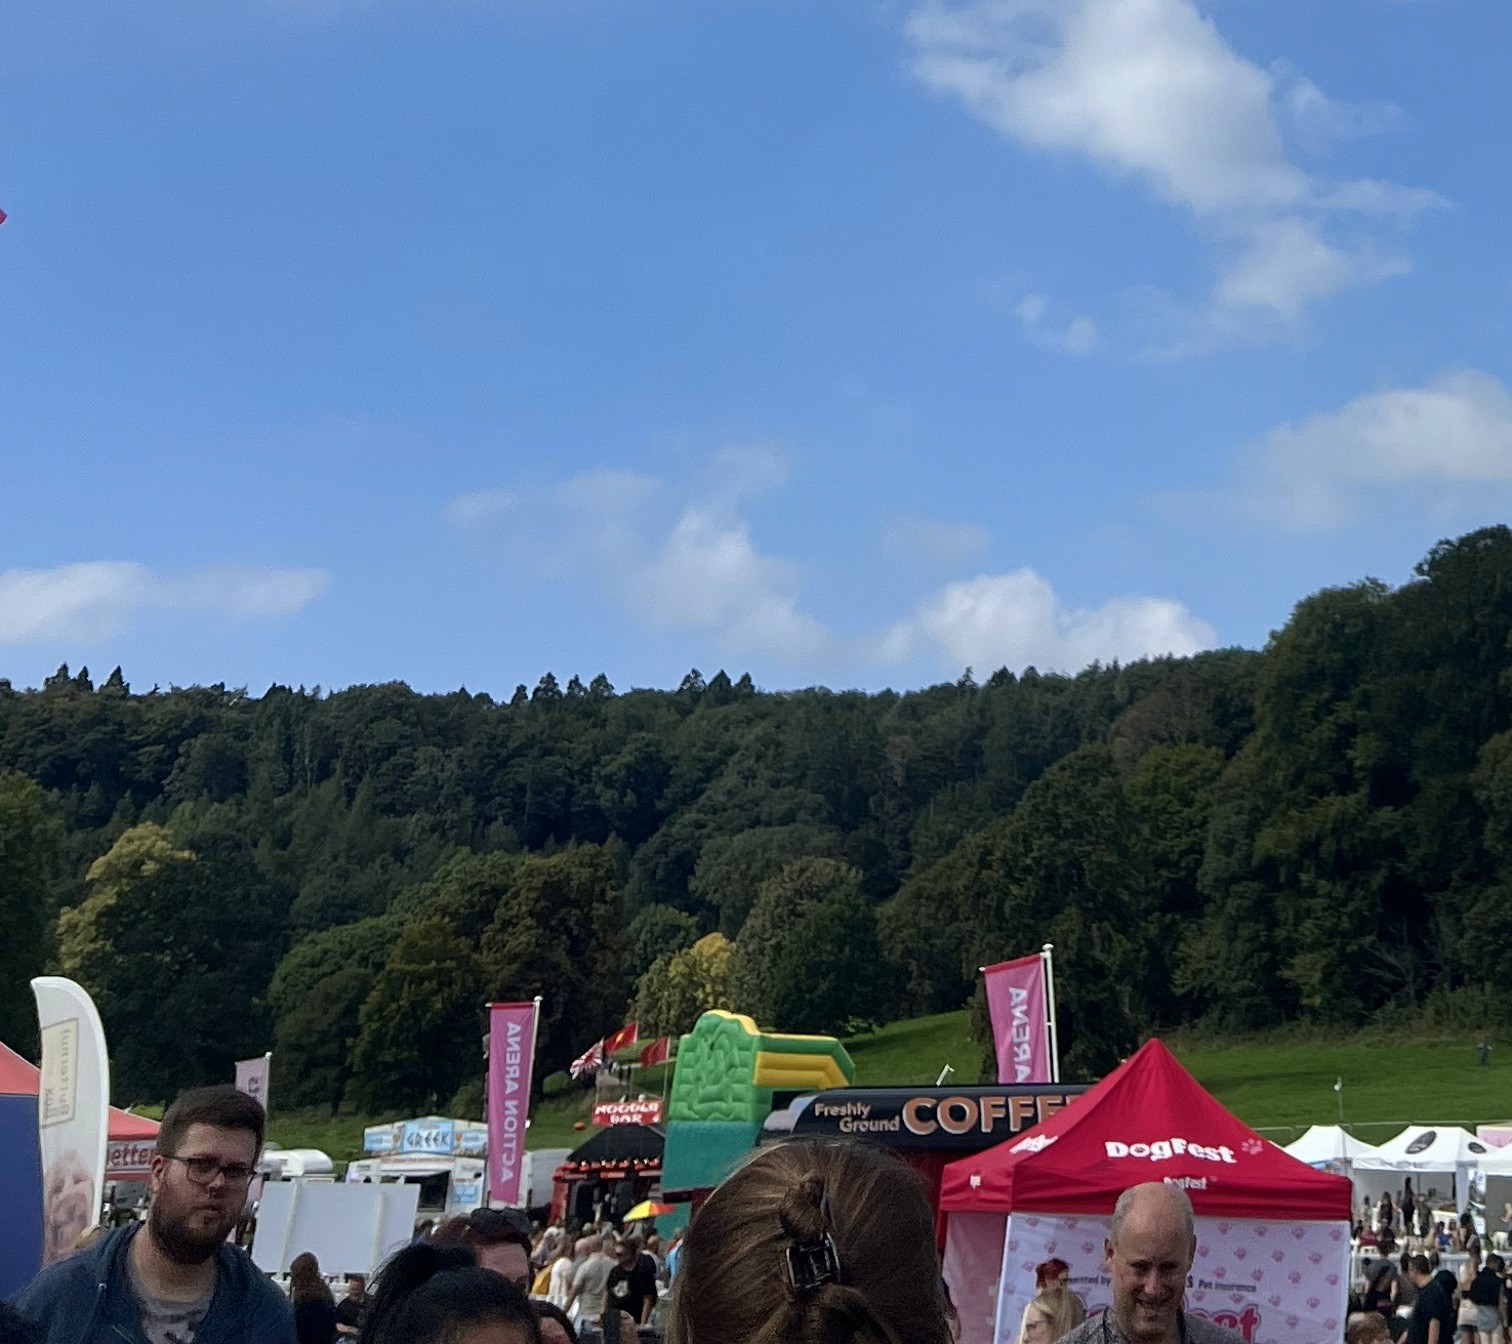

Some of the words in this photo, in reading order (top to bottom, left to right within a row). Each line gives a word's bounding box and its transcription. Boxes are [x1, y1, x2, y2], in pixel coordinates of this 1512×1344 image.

[814, 1102, 871, 1121] Freshly
[902, 1096, 1083, 1135] COFFE
[839, 1115, 899, 1133] Ground
[407, 1132, 449, 1148] GREEK
